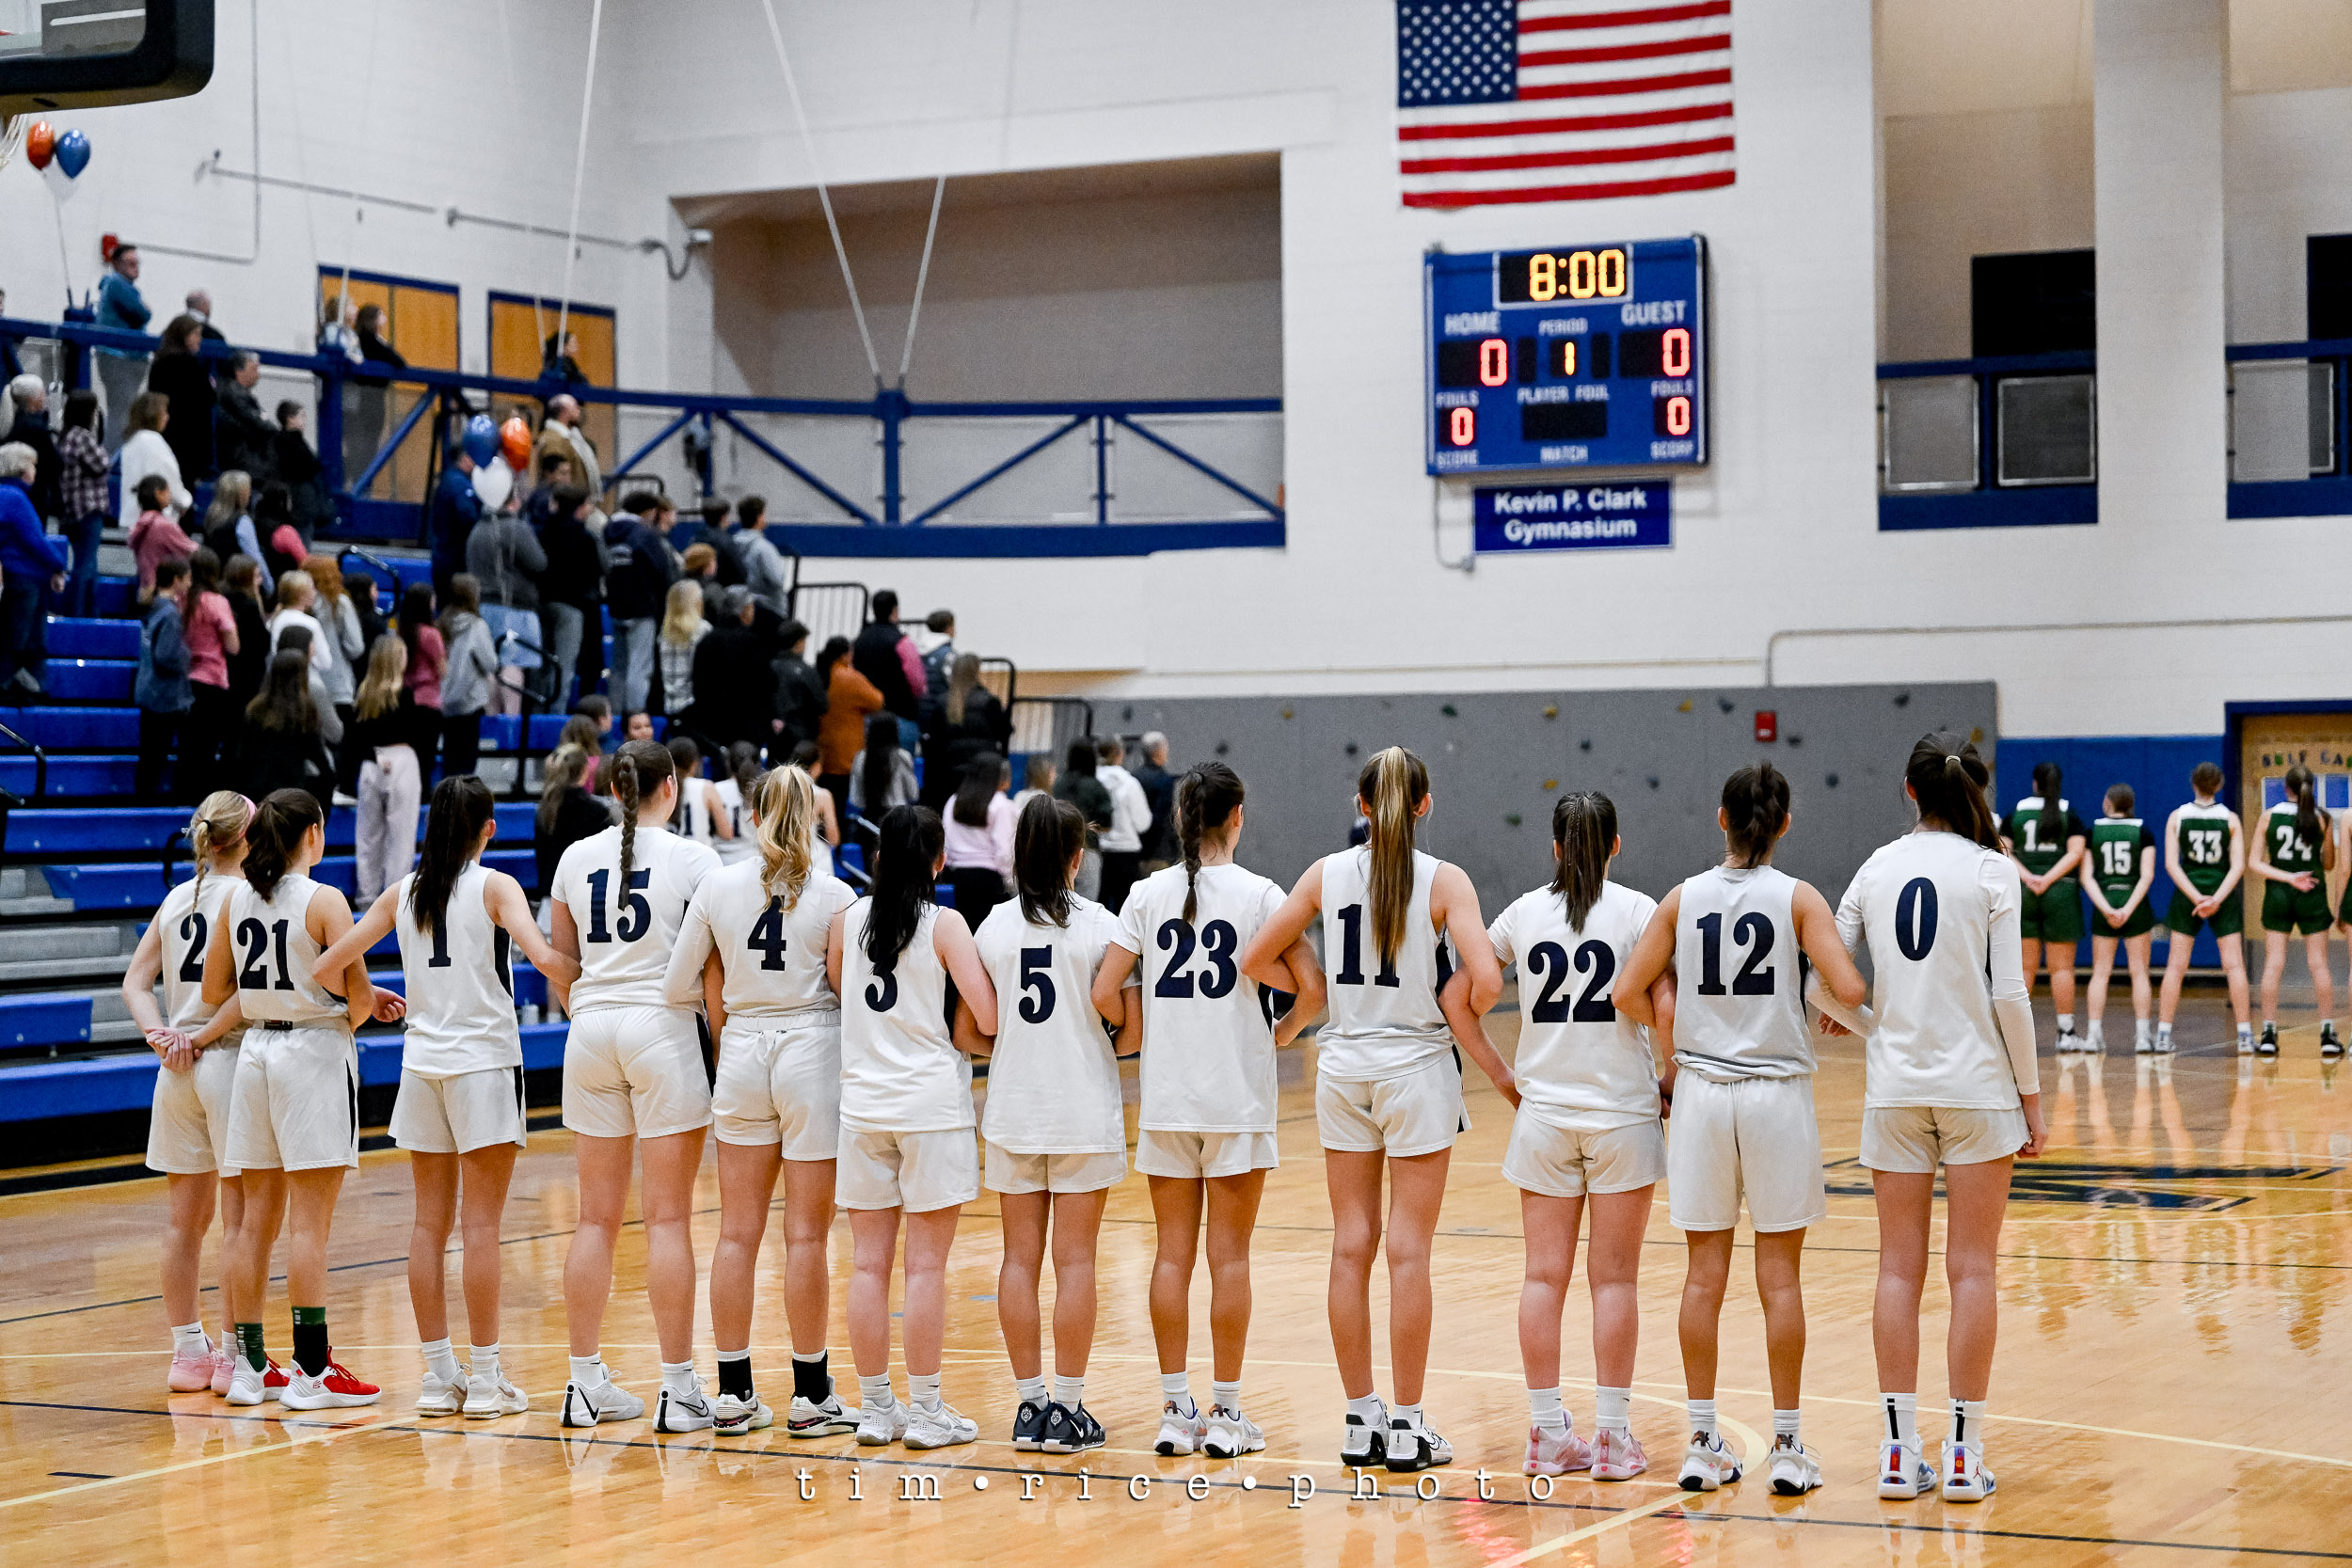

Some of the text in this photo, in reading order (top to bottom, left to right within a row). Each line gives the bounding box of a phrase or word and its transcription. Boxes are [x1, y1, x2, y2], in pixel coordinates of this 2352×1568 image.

[1529, 249, 1625, 301] 8:00
[1444, 310, 1501, 336] HOME
[1621, 300, 1687, 326] GUEST
[1480, 339, 1508, 387] 0
[1565, 341, 1575, 376] 1
[1662, 328, 1691, 377] 0
[1517, 386, 1569, 404] PLAYER
[1667, 396, 1690, 436] 0
[1451, 407, 1473, 446] 0
[1494, 486, 1646, 515] Kevin P. Clark
[1505, 516, 1637, 546] Gymnasium
[2024, 819, 2058, 852] 1
[2100, 840, 2132, 876] 15
[2188, 830, 2223, 863] 33
[2277, 825, 2312, 862] 24
[587, 867, 651, 942] 15
[1895, 877, 1938, 960] 0
[237, 917, 294, 990] 21
[428, 911, 452, 968] 1
[748, 895, 787, 971] 4
[1697, 912, 1775, 995] 12
[865, 941, 898, 1012] 3
[1155, 918, 1237, 998] 23
[1528, 940, 1616, 1023] 22
[1019, 944, 1056, 1023] 5
